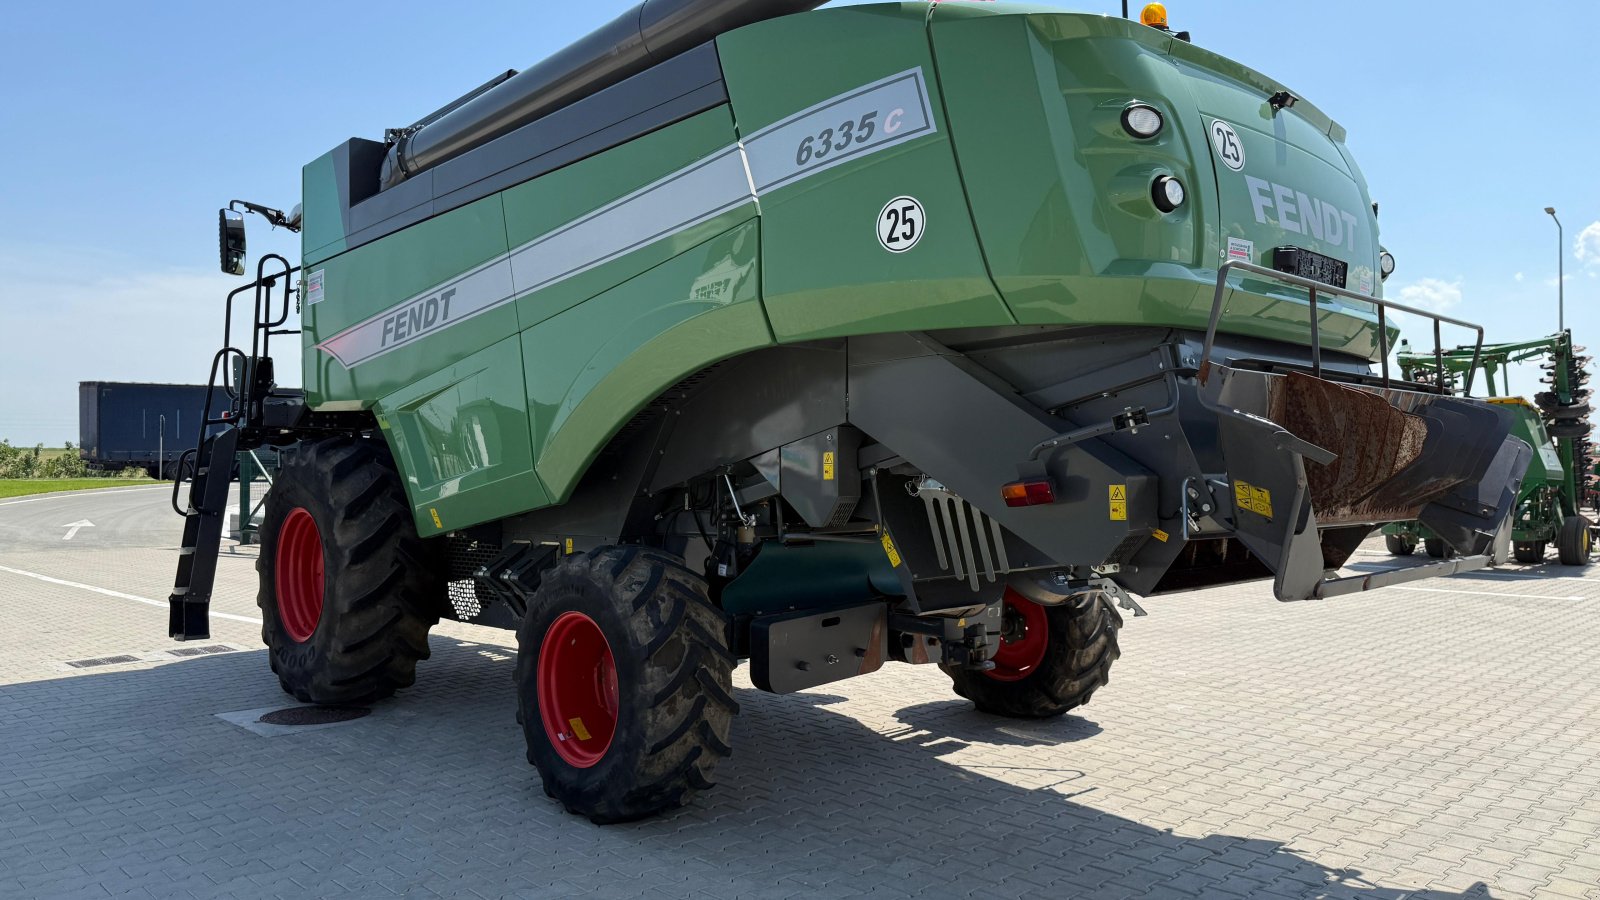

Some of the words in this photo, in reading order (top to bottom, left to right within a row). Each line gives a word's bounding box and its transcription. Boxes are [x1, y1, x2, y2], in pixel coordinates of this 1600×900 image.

[796, 110, 878, 166] 6335
[883, 108, 904, 134] C
[1216, 127, 1240, 163] 25
[886, 205, 915, 244] 25
[1244, 174, 1358, 251] FENDT
[381, 287, 457, 348] FENDT
